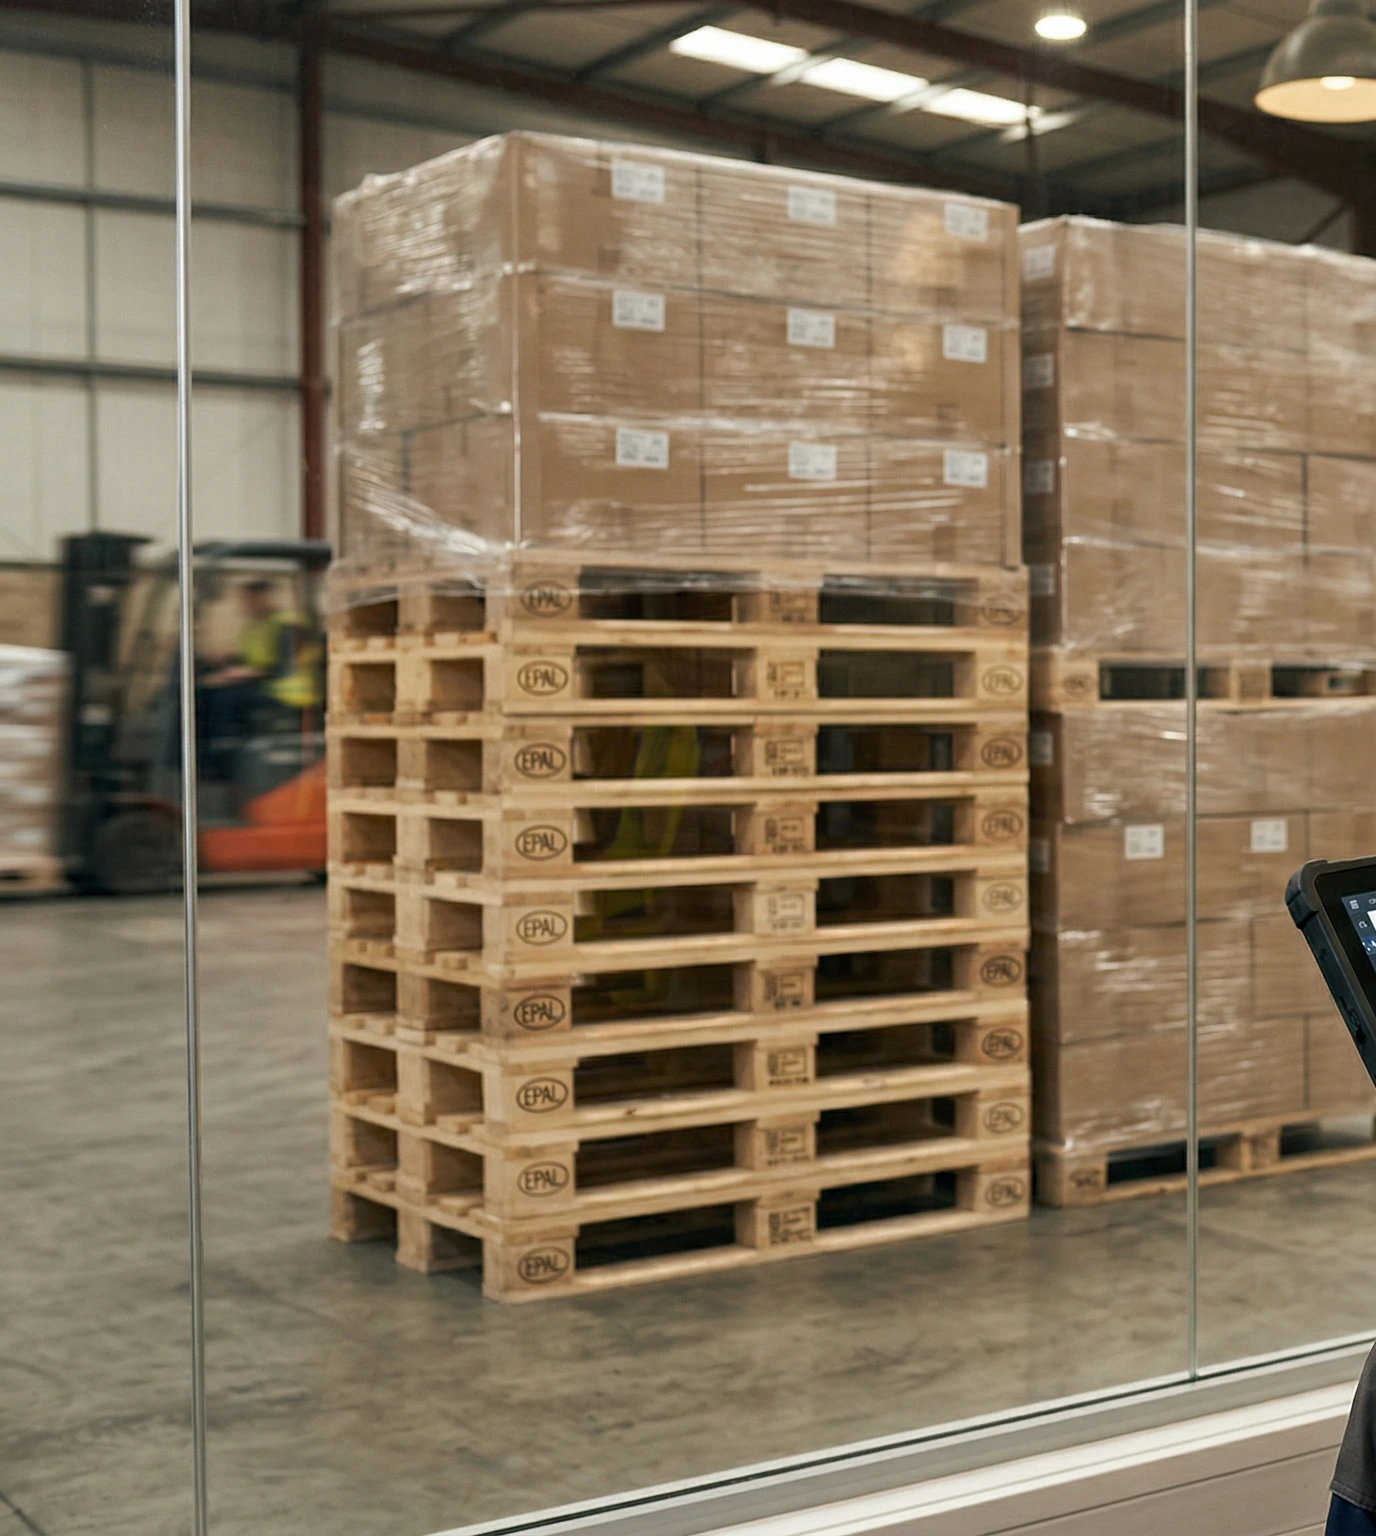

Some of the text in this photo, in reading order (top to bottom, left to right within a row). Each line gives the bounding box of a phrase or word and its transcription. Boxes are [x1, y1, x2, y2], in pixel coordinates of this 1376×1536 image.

[525, 668, 560, 689] EPAL
[522, 750, 557, 772] EPAL
[523, 832, 558, 855] EPAL
[523, 917, 557, 939] EPAL
[521, 1000, 556, 1025] EPAL
[524, 1084, 558, 1108] EPAL
[525, 1167, 559, 1191] EPAL
[525, 1252, 560, 1277] EPAL
